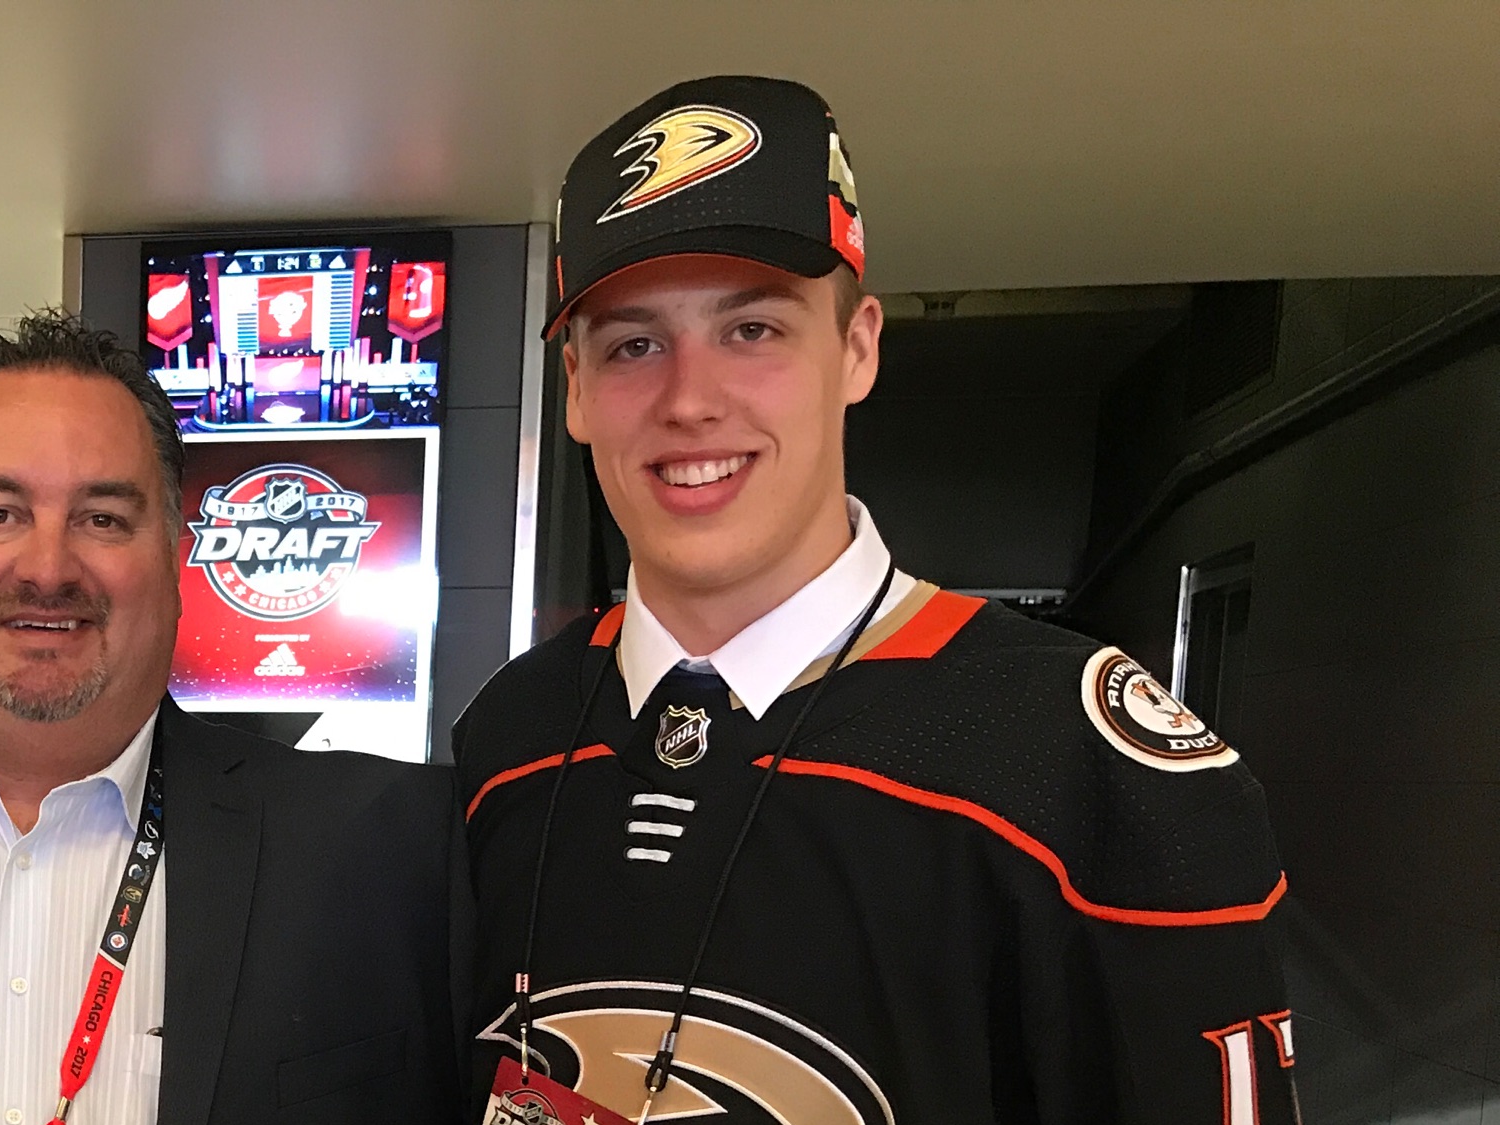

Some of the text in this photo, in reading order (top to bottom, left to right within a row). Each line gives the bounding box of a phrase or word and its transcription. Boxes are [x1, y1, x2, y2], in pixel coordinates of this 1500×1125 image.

[217, 504, 259, 516] 1917
[315, 496, 356, 508] 2017
[194, 527, 376, 561] DRAFT
[249, 590, 318, 611] CHICAGO
[1107, 661, 1138, 708] ANAH
[665, 723, 697, 753] NHL
[1167, 730, 1221, 750] DUCK
[85, 970, 114, 1032] CHICAGO
[70, 1045, 88, 1080] 2017
